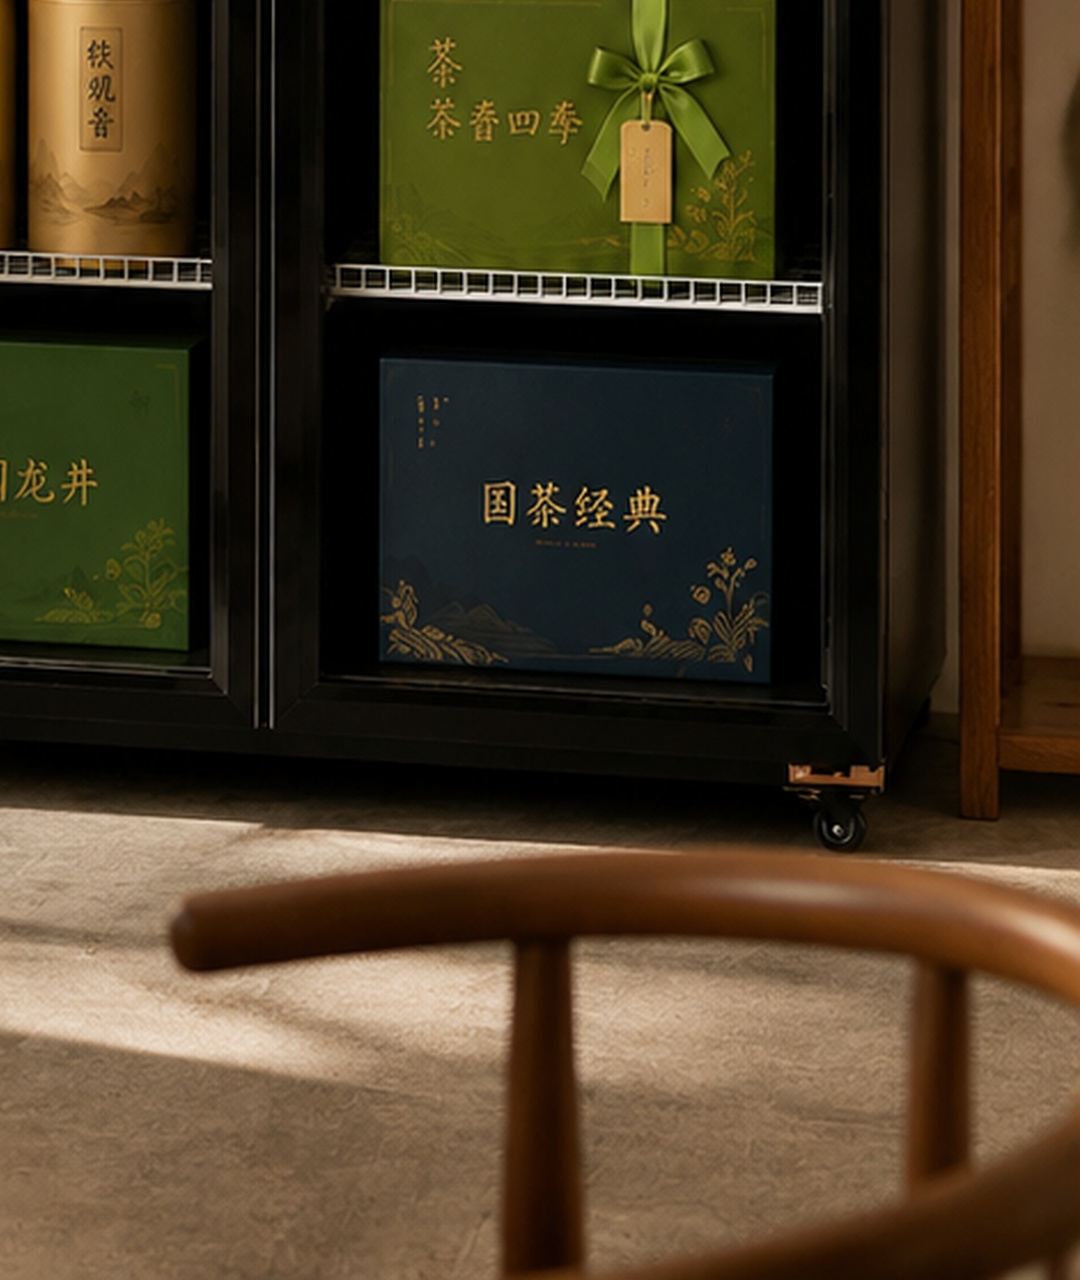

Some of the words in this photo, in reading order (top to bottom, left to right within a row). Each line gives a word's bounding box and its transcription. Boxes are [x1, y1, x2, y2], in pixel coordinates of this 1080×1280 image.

[427, 37, 463, 88] 茶
[483, 480, 668, 534] 国茶经典
